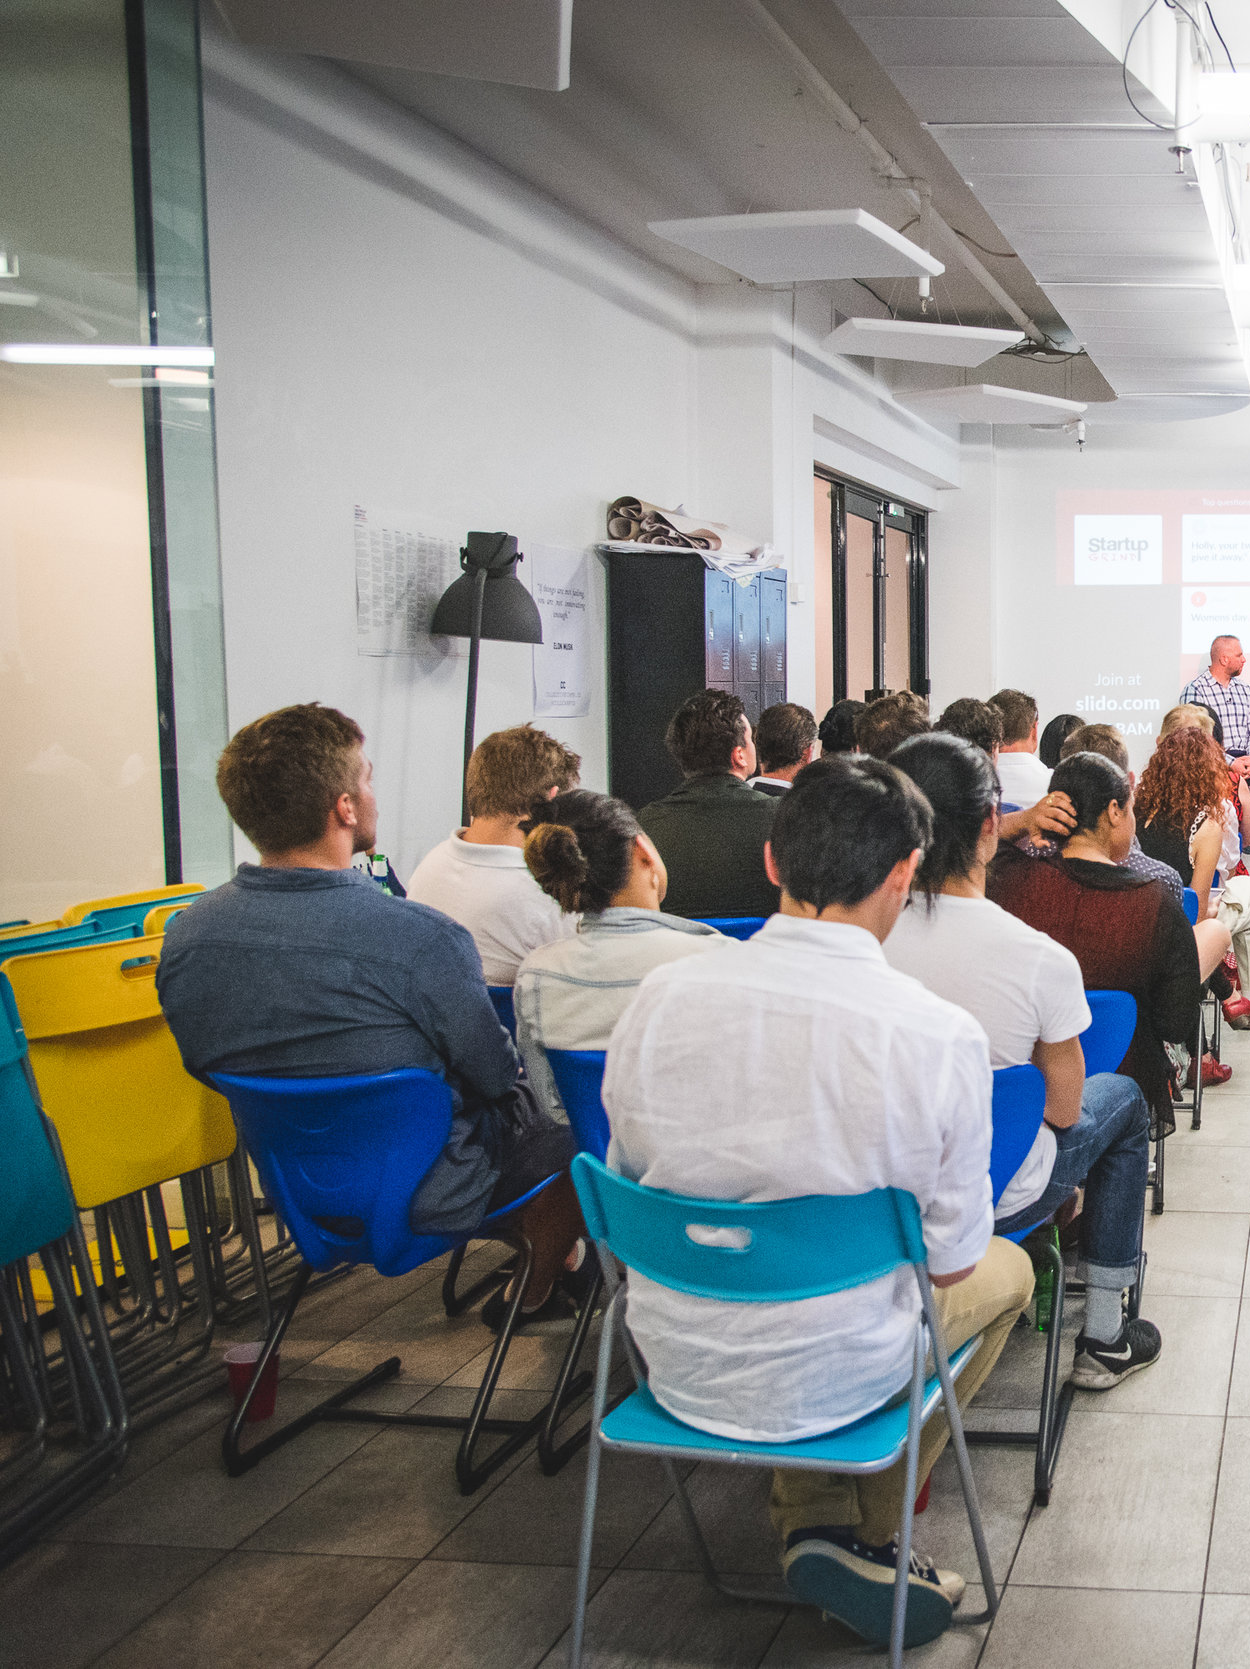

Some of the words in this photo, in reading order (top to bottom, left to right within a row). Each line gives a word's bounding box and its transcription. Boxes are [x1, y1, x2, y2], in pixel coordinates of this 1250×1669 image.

[1088, 537, 1149, 562] Startup
[1191, 612, 1229, 621] Womens
[1095, 673, 1124, 687] Join
[1127, 673, 1142, 686] at
[1075, 696, 1160, 712] slido.com
